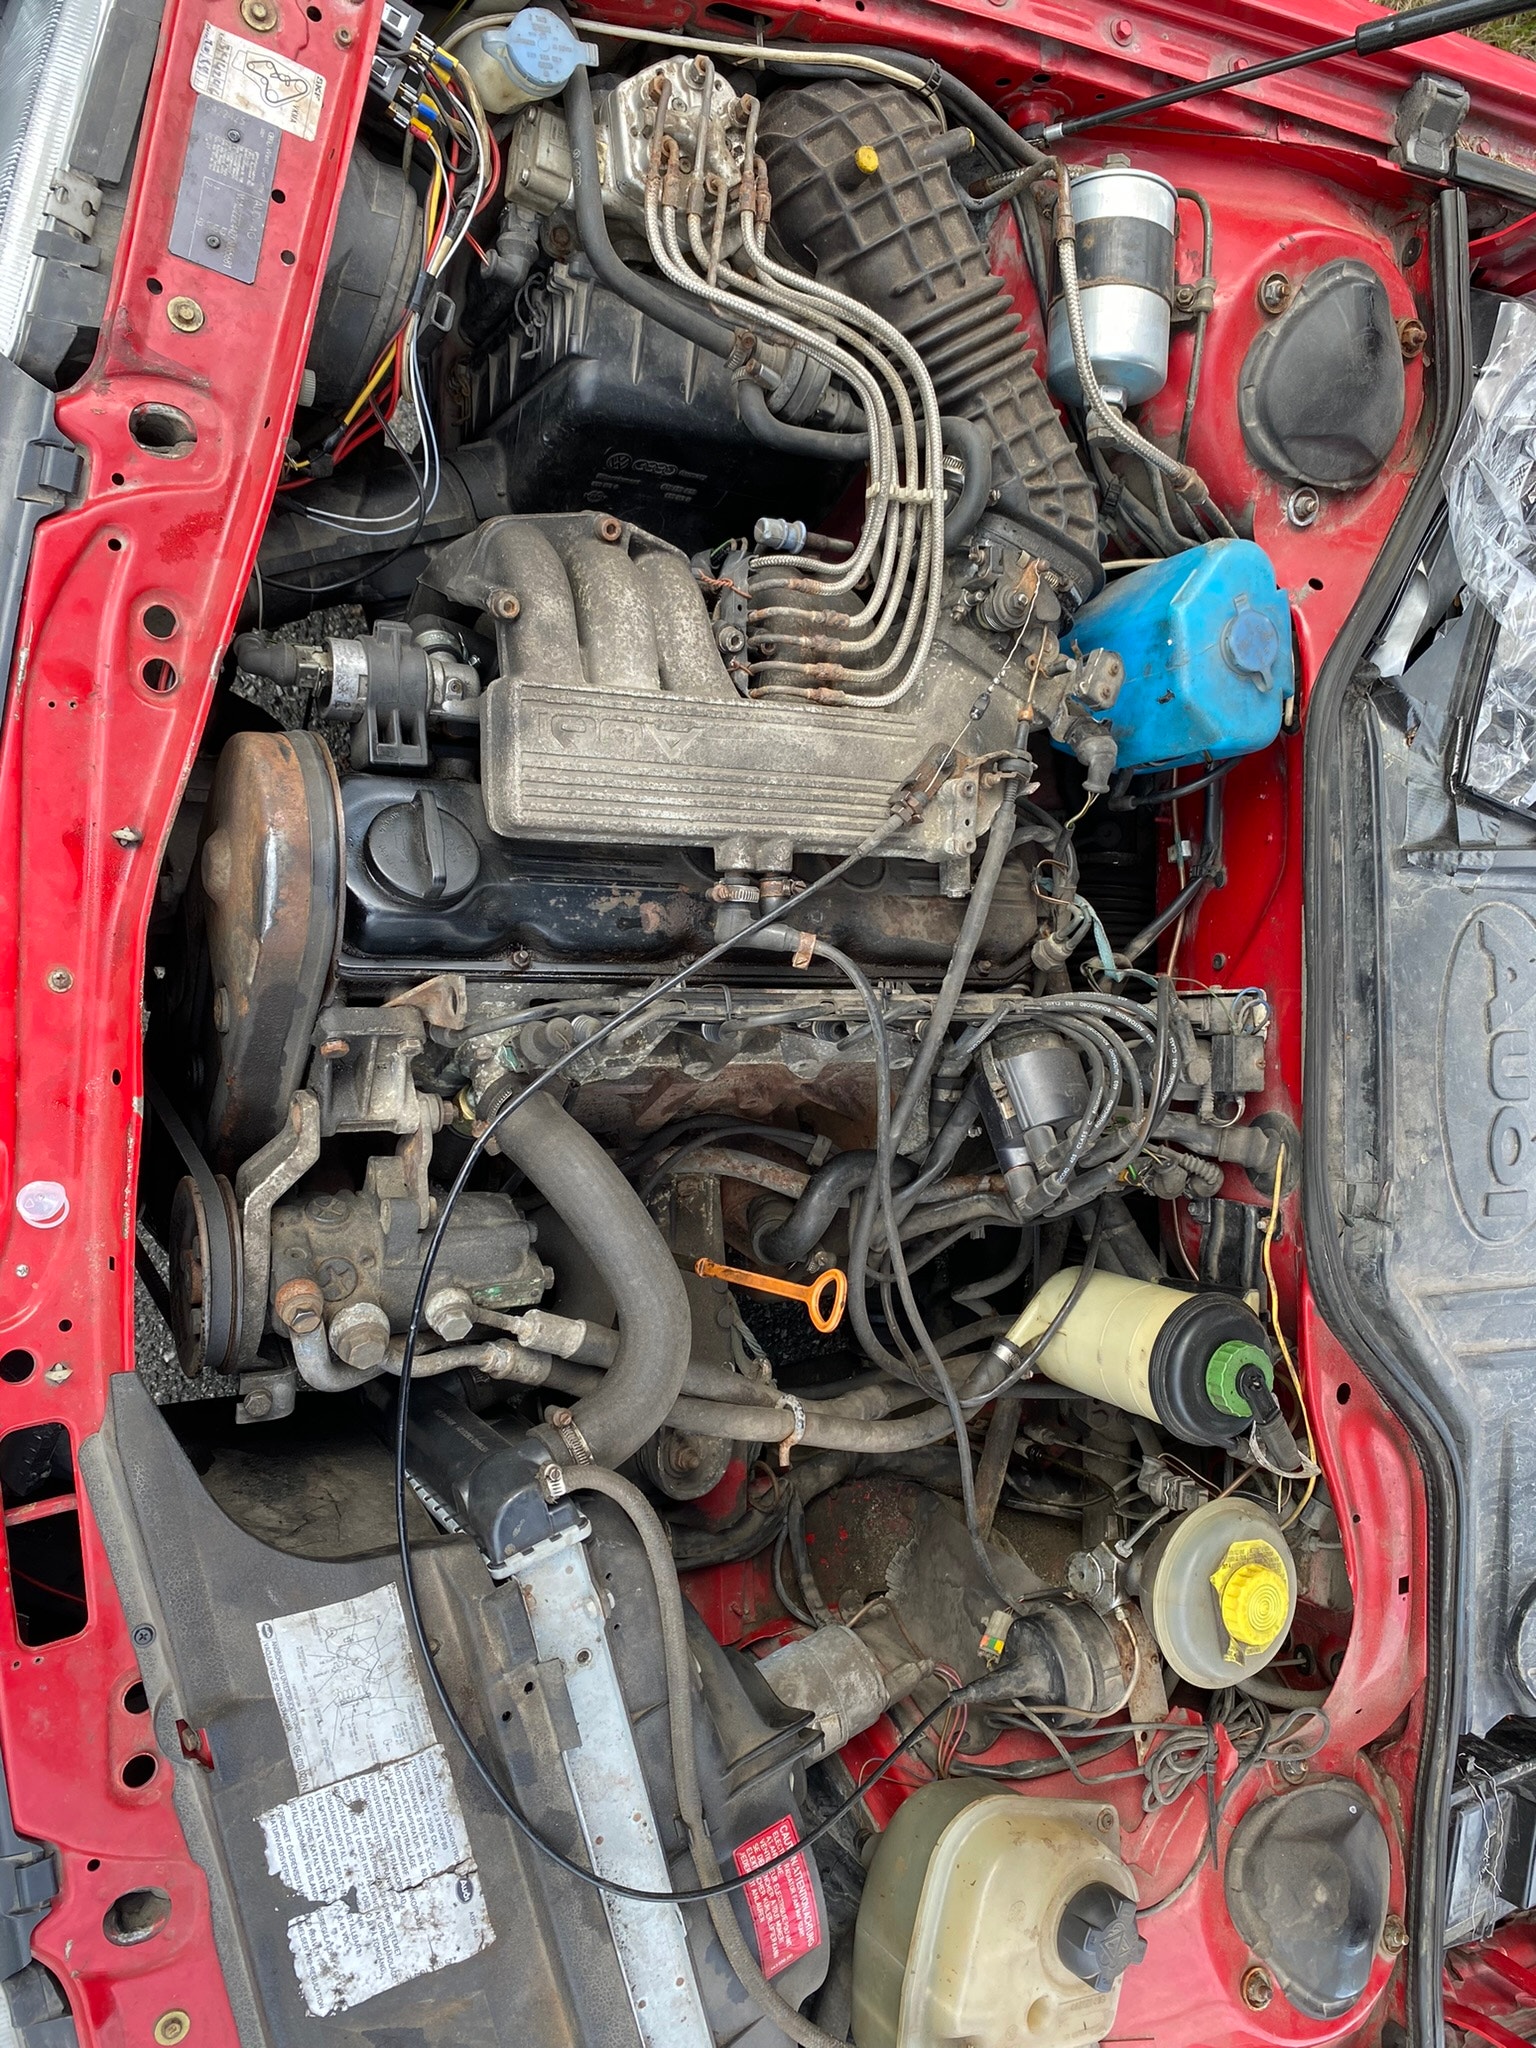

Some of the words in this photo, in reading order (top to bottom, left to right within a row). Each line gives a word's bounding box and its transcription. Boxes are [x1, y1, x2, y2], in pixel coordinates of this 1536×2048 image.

[311, 75, 325, 101] SKF
[1115, 1011, 1145, 1032] AUTORADIO
[1076, 1130, 1088, 1149] CLASS
[375, 1770, 388, 1788] ALLA
[425, 1750, 443, 1797] INFORMATION
[437, 1796, 447, 1809] OM
[305, 1795, 320, 1827] CO-HALT
[313, 1826, 324, 1838] PÅ
[380, 1787, 398, 1830] ELEKTRISKA
[302, 1822, 316, 1844] FÖRE
[359, 1819, 371, 1836] FÖR
[751, 1841, 761, 1854] SE
[765, 1834, 774, 1844] AT
[303, 1860, 313, 1874] VID
[354, 1836, 368, 1863] UNDER
[373, 1910, 382, 1921] AV
[359, 1890, 371, 1911] FÖRE
[467, 1910, 478, 1928] AUDI
